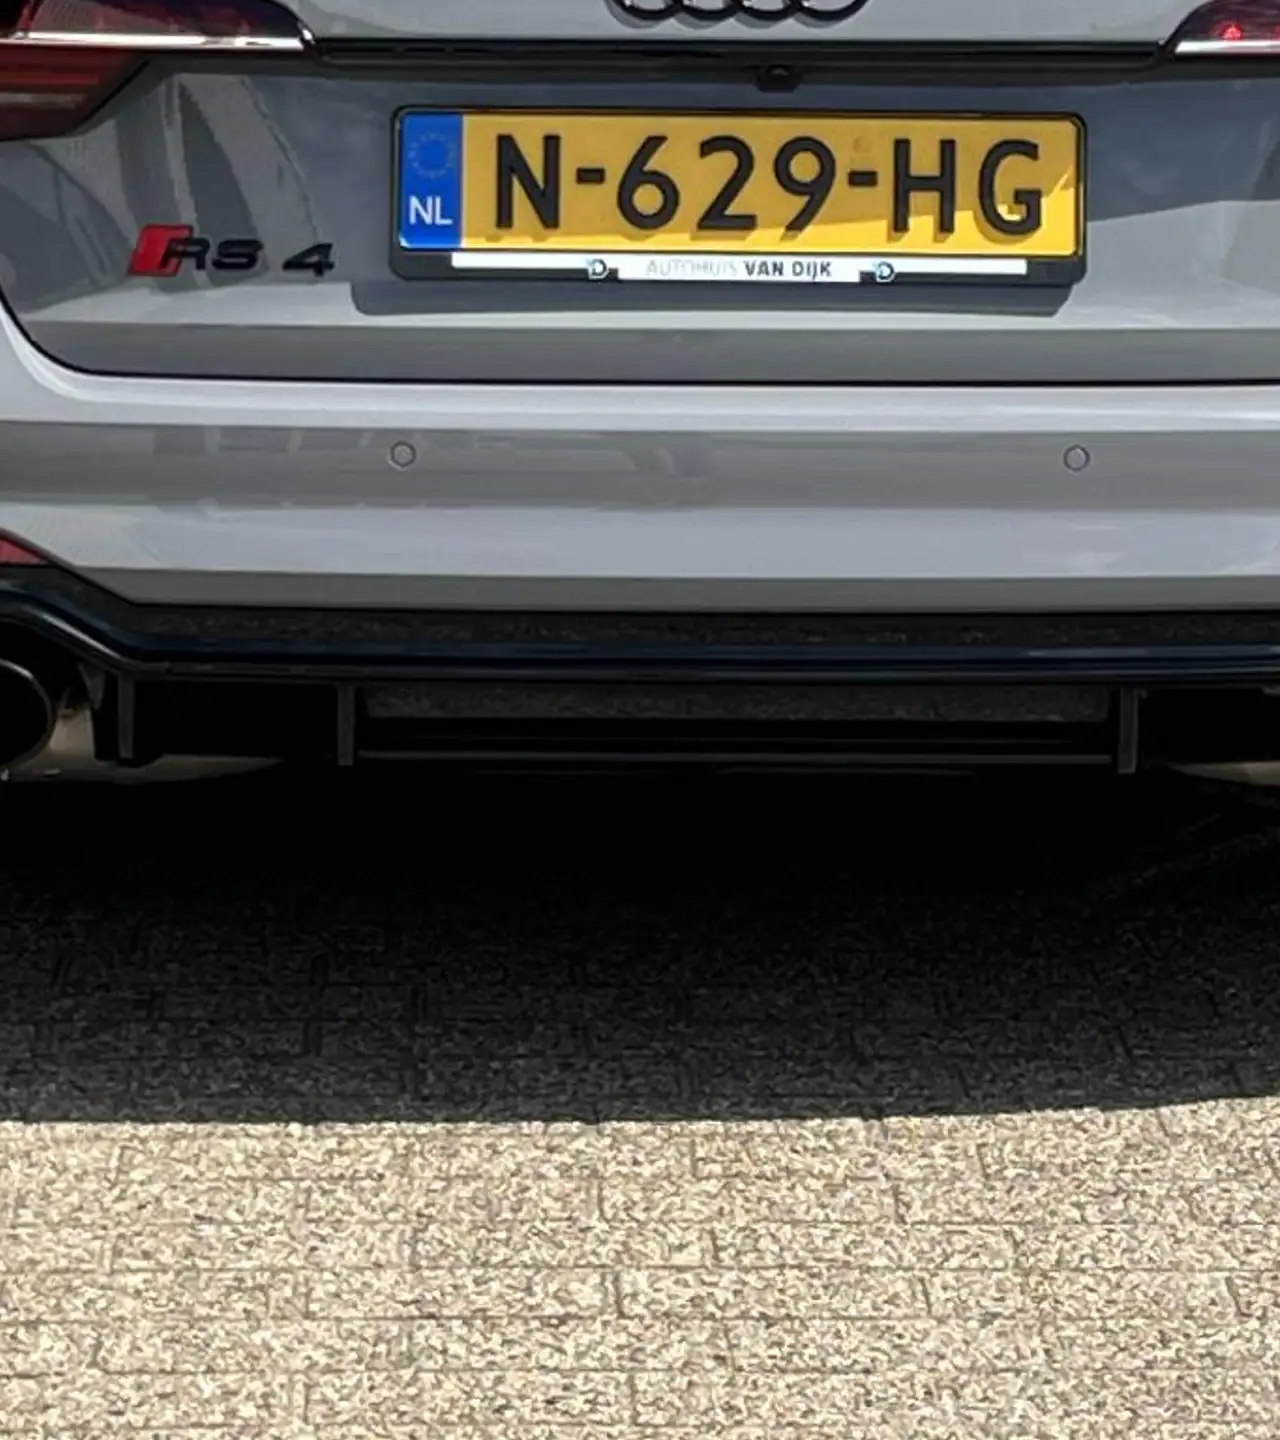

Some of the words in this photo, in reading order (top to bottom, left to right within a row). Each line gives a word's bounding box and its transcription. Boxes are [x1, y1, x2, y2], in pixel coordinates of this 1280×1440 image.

[494, 133, 1043, 238] N-629-HG
[408, 196, 452, 226] NL
[128, 224, 263, 276] RS
[281, 242, 336, 277] 4
[743, 260, 785, 277] VAN
[791, 260, 832, 281] DIJK
